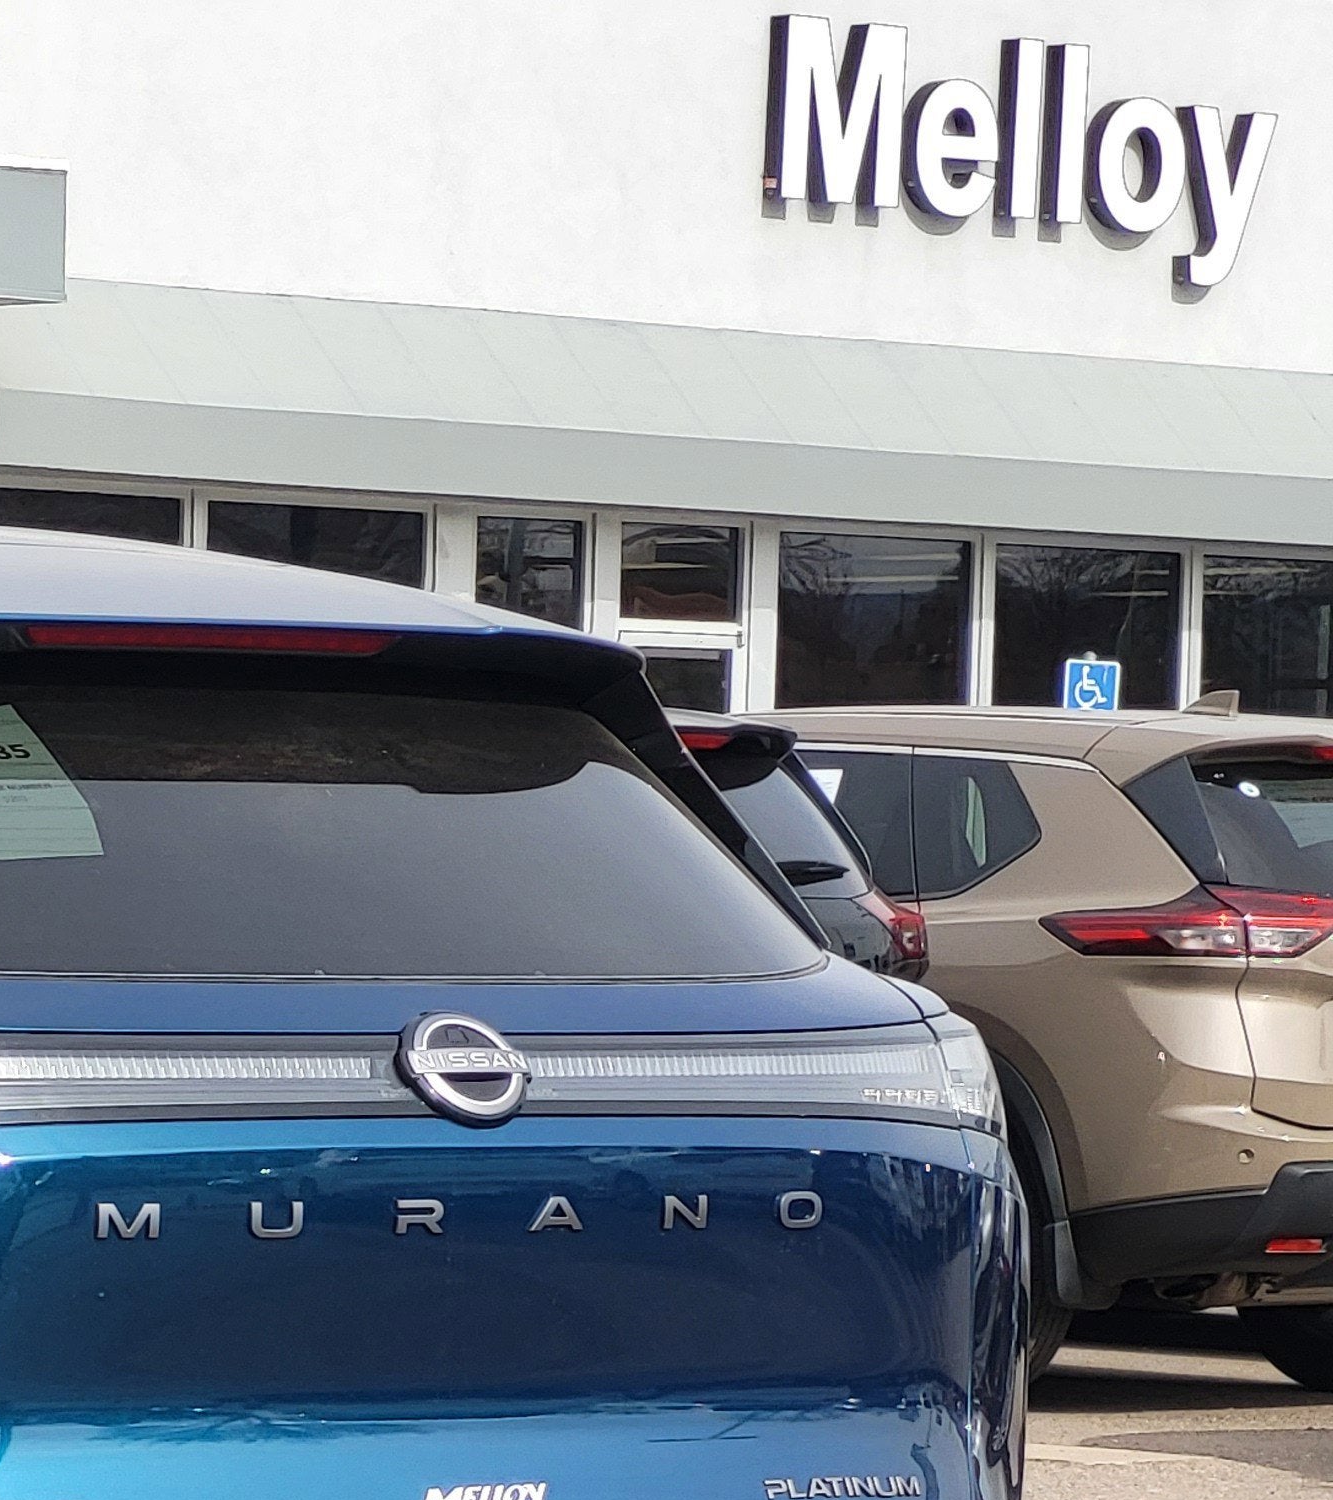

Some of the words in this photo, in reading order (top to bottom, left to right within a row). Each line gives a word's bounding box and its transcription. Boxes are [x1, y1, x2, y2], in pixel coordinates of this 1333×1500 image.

[763, 14, 1279, 288] Melloy
[412, 1050, 529, 1070] NISSAN
[95, 1188, 825, 1240] MURANO
[763, 1475, 921, 1500] PLATINUM
